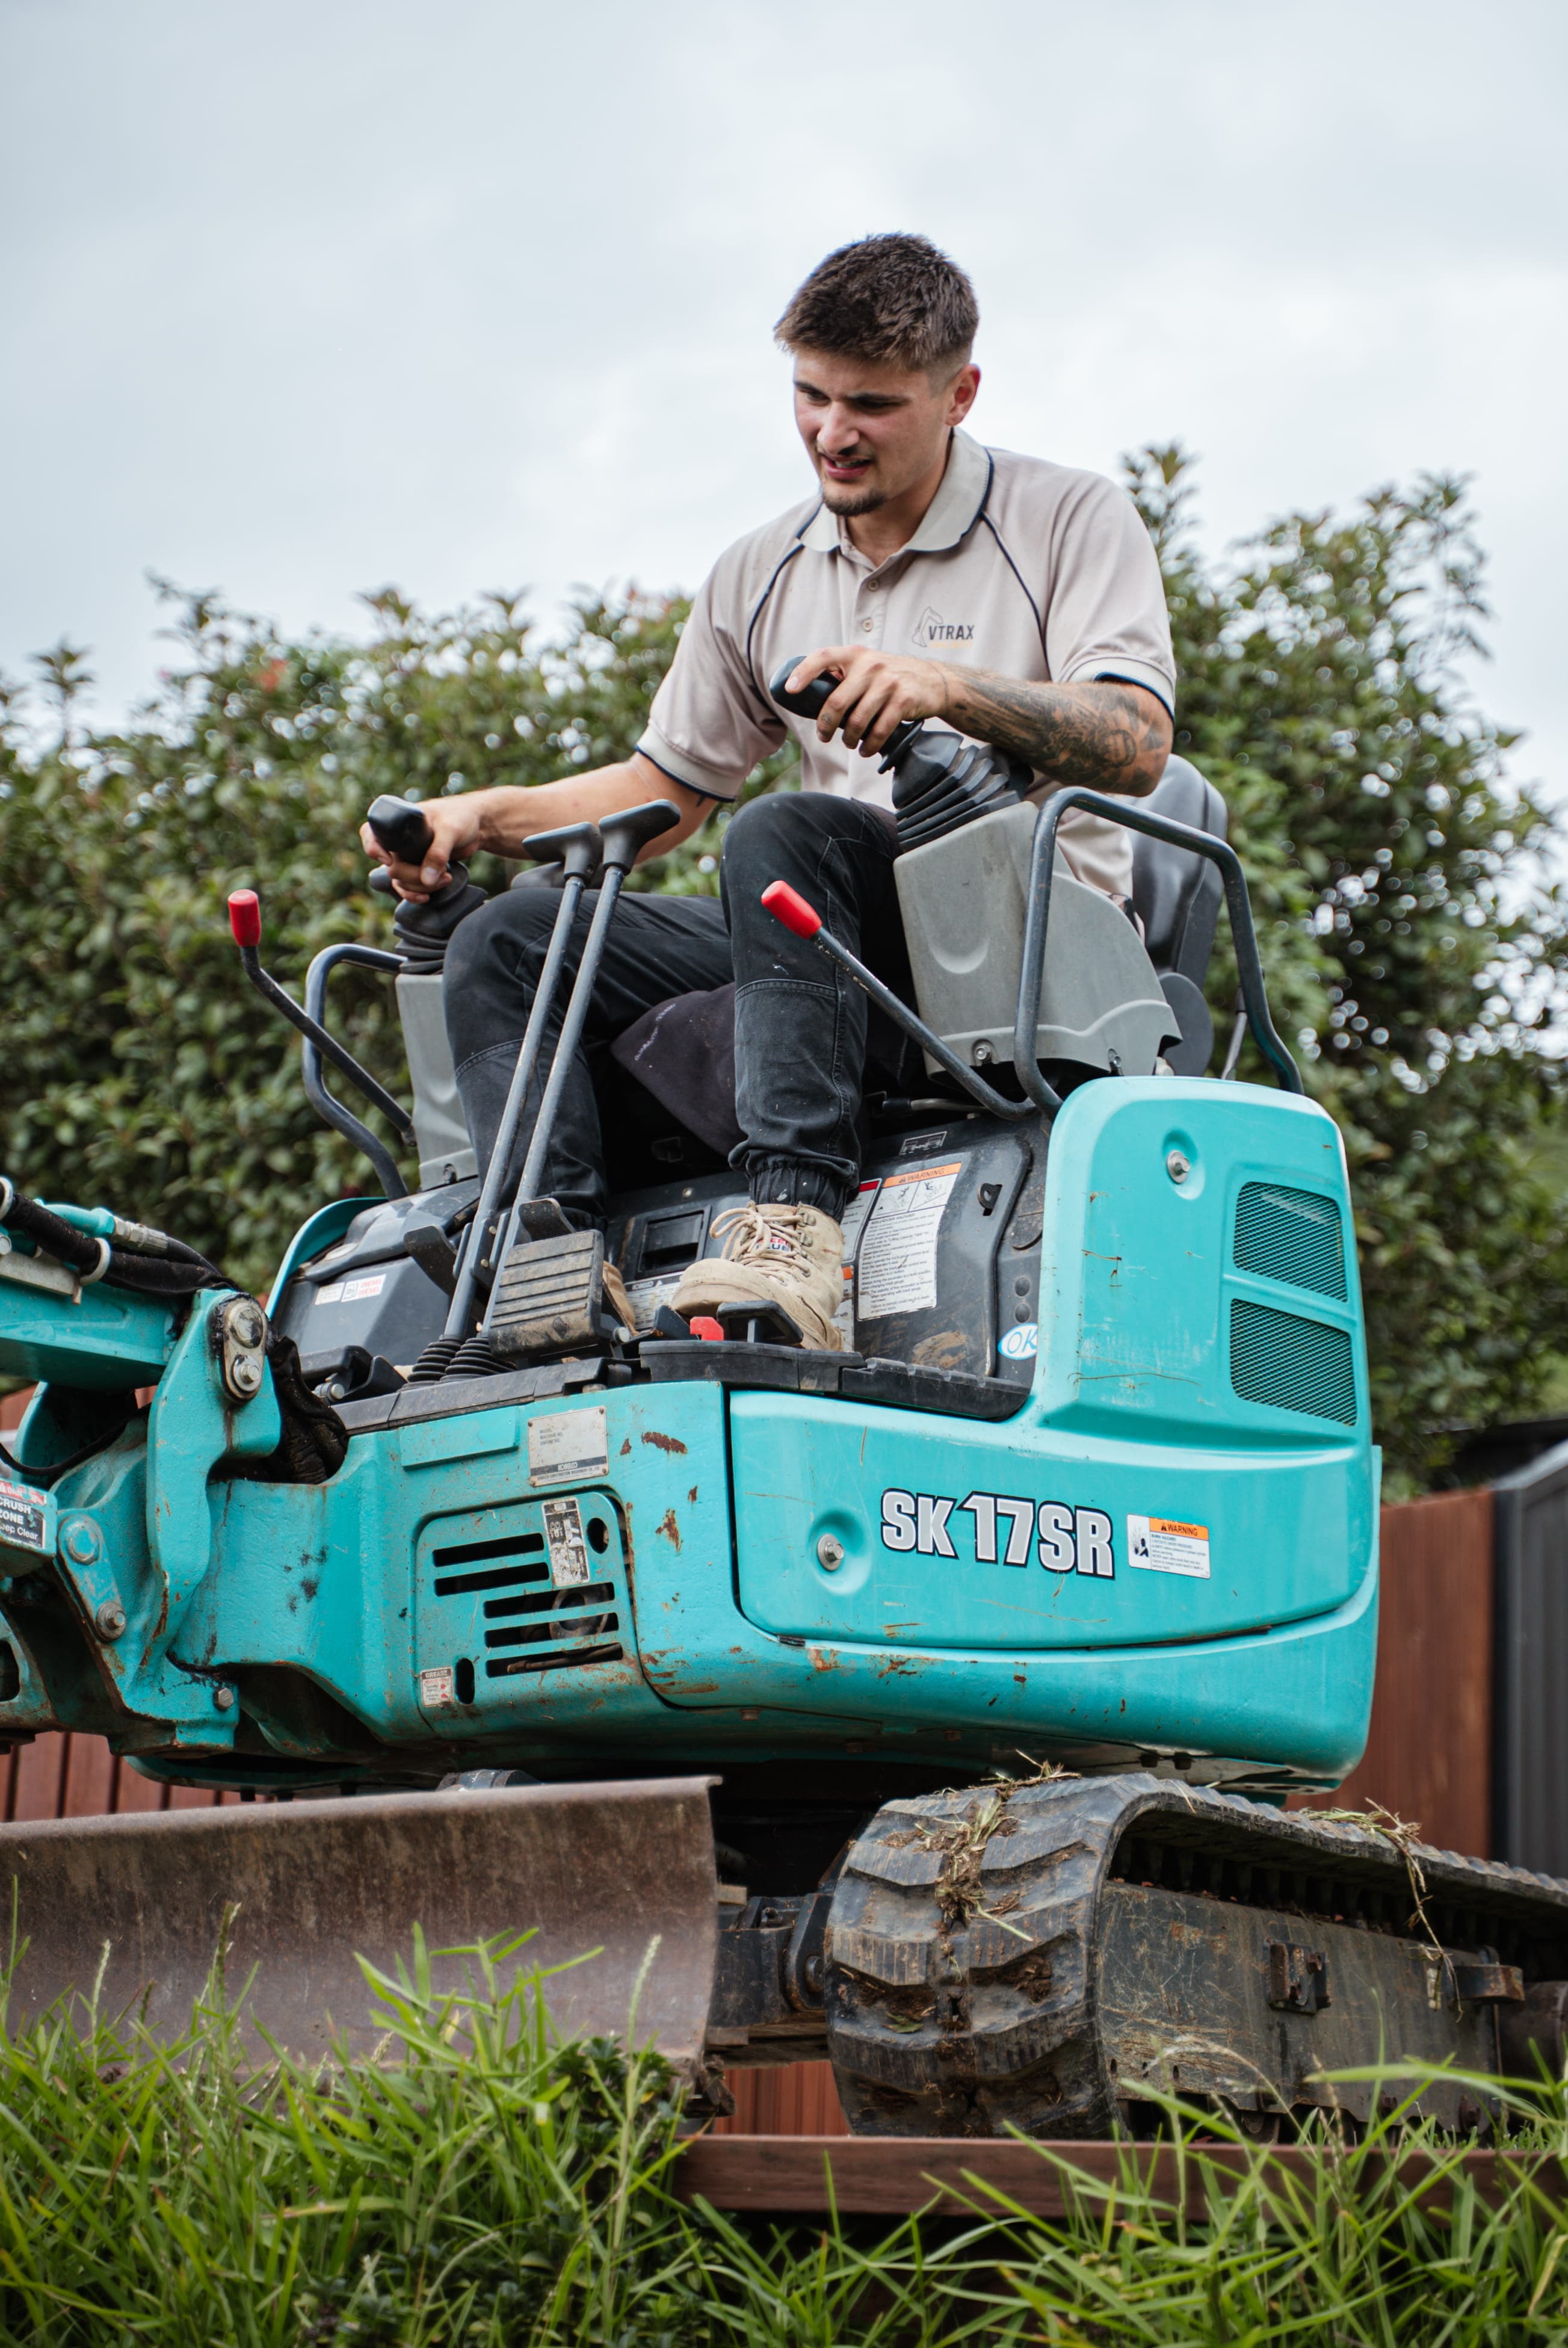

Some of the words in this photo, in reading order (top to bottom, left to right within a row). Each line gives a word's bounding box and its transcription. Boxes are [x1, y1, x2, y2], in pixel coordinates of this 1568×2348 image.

[928, 624, 975, 640] VTRAX
[907, 1168, 945, 1181] WARNING
[1007, 1328, 1039, 1354] OK
[17, 1527, 39, 1540] Clear
[1168, 1524, 1198, 1536] WARNING
[425, 1670, 448, 1678] GREASE
